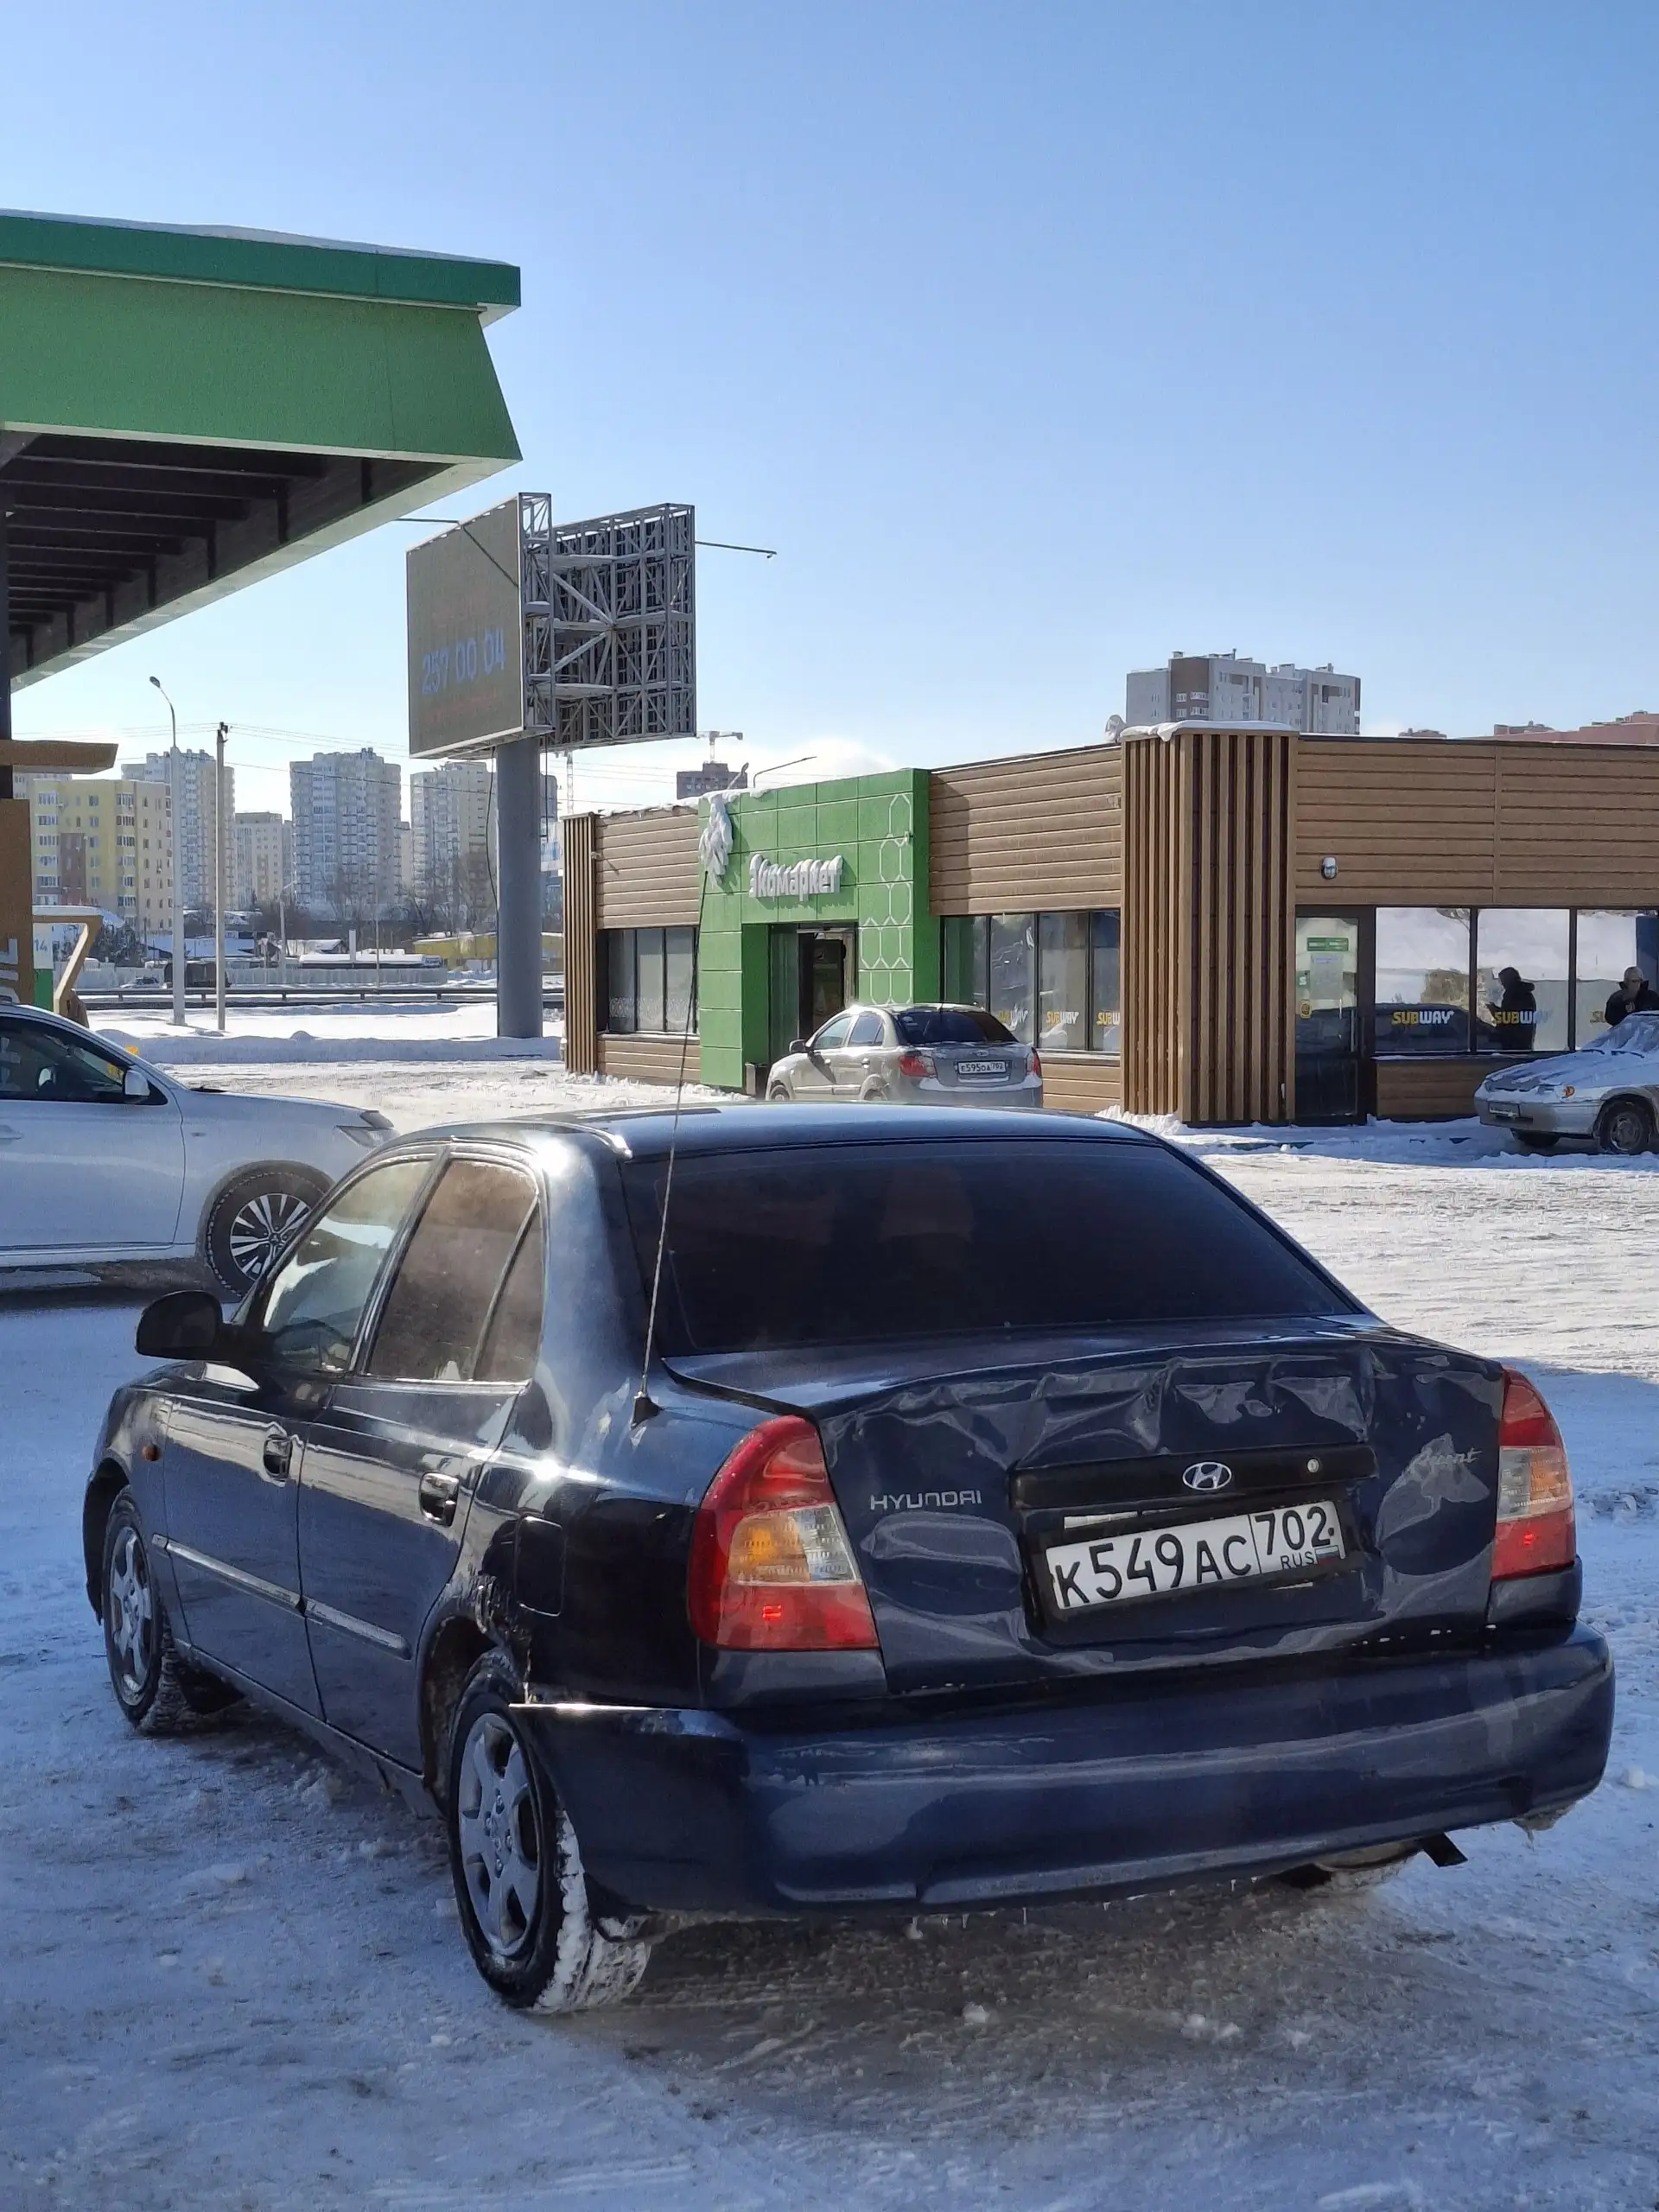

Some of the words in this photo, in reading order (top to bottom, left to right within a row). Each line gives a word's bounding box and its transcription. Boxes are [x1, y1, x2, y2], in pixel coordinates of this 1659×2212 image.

[422, 649, 450, 695] 257
[1046, 1011, 1079, 1025] SUBWAY
[1096, 1012, 1121, 1026] SUBW
[1391, 1009, 1455, 1026] SUBWAY
[870, 1489, 982, 1511] HYUNDAI
[1280, 1550, 1315, 1570] RUS
